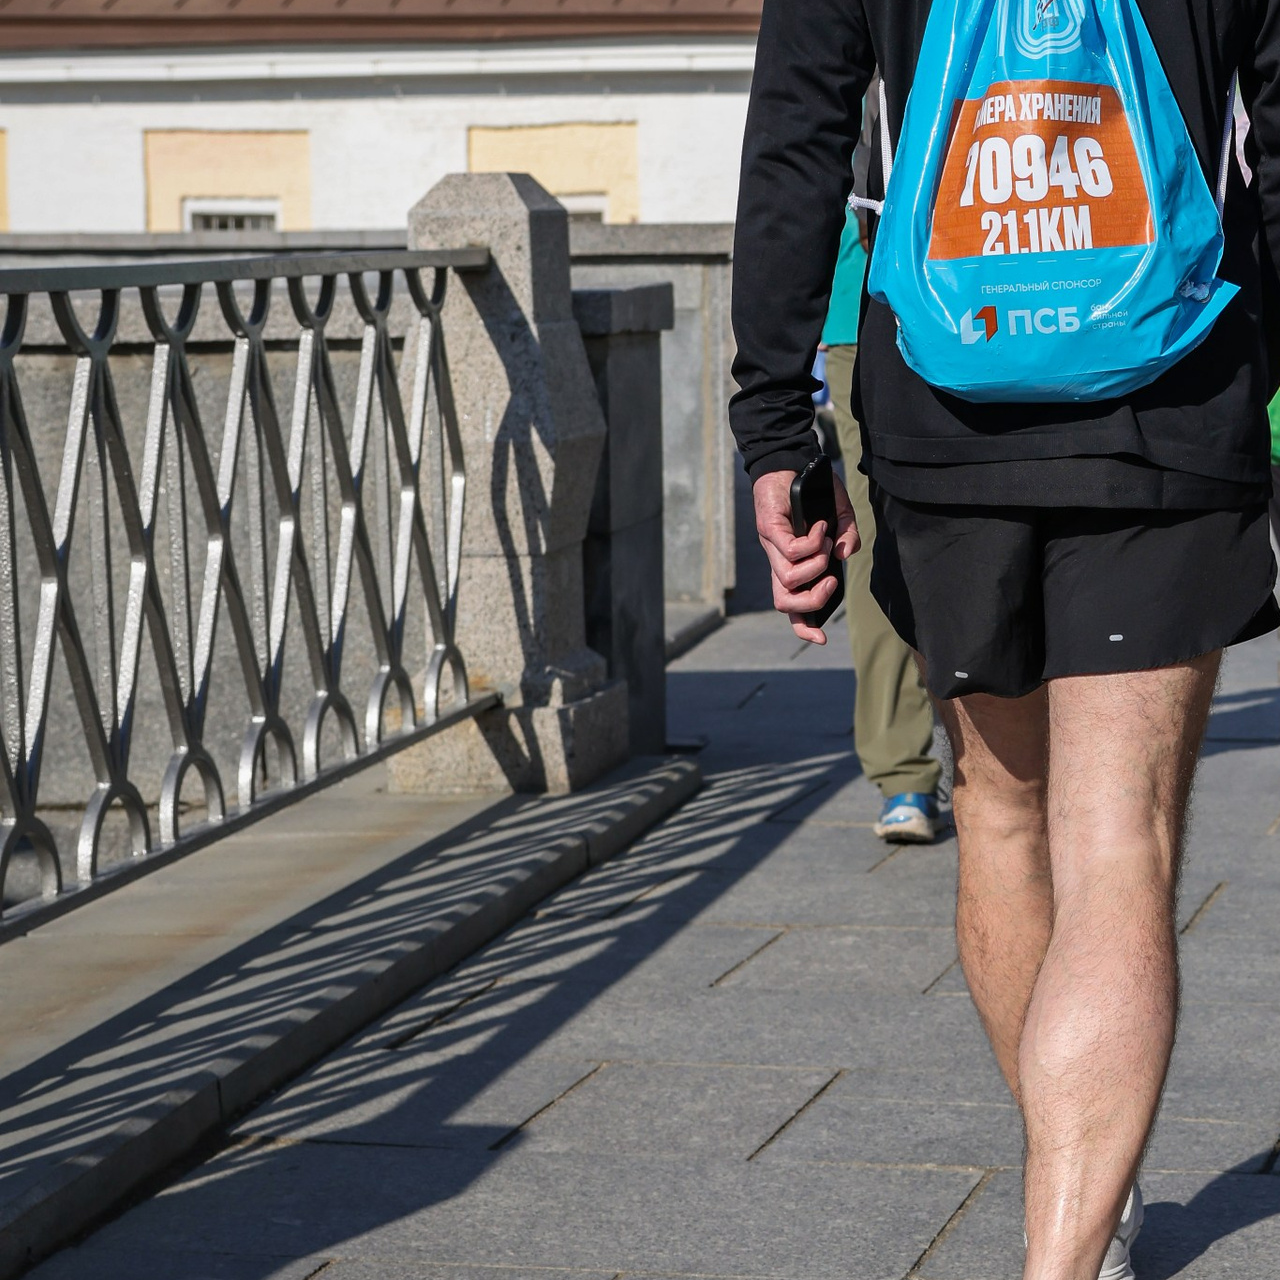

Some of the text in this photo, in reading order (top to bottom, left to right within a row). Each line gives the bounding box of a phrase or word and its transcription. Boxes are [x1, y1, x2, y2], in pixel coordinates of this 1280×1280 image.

[1019, 93, 1101, 125] ХРАНЕНИЯ
[960, 134, 1114, 207] 70946
[981, 279, 1102, 294] ГЕНЕРАЛЬНЫЙ СПОНСОР
[1008, 307, 1081, 336] ПСБ
[1092, 320, 1127, 330] страны
